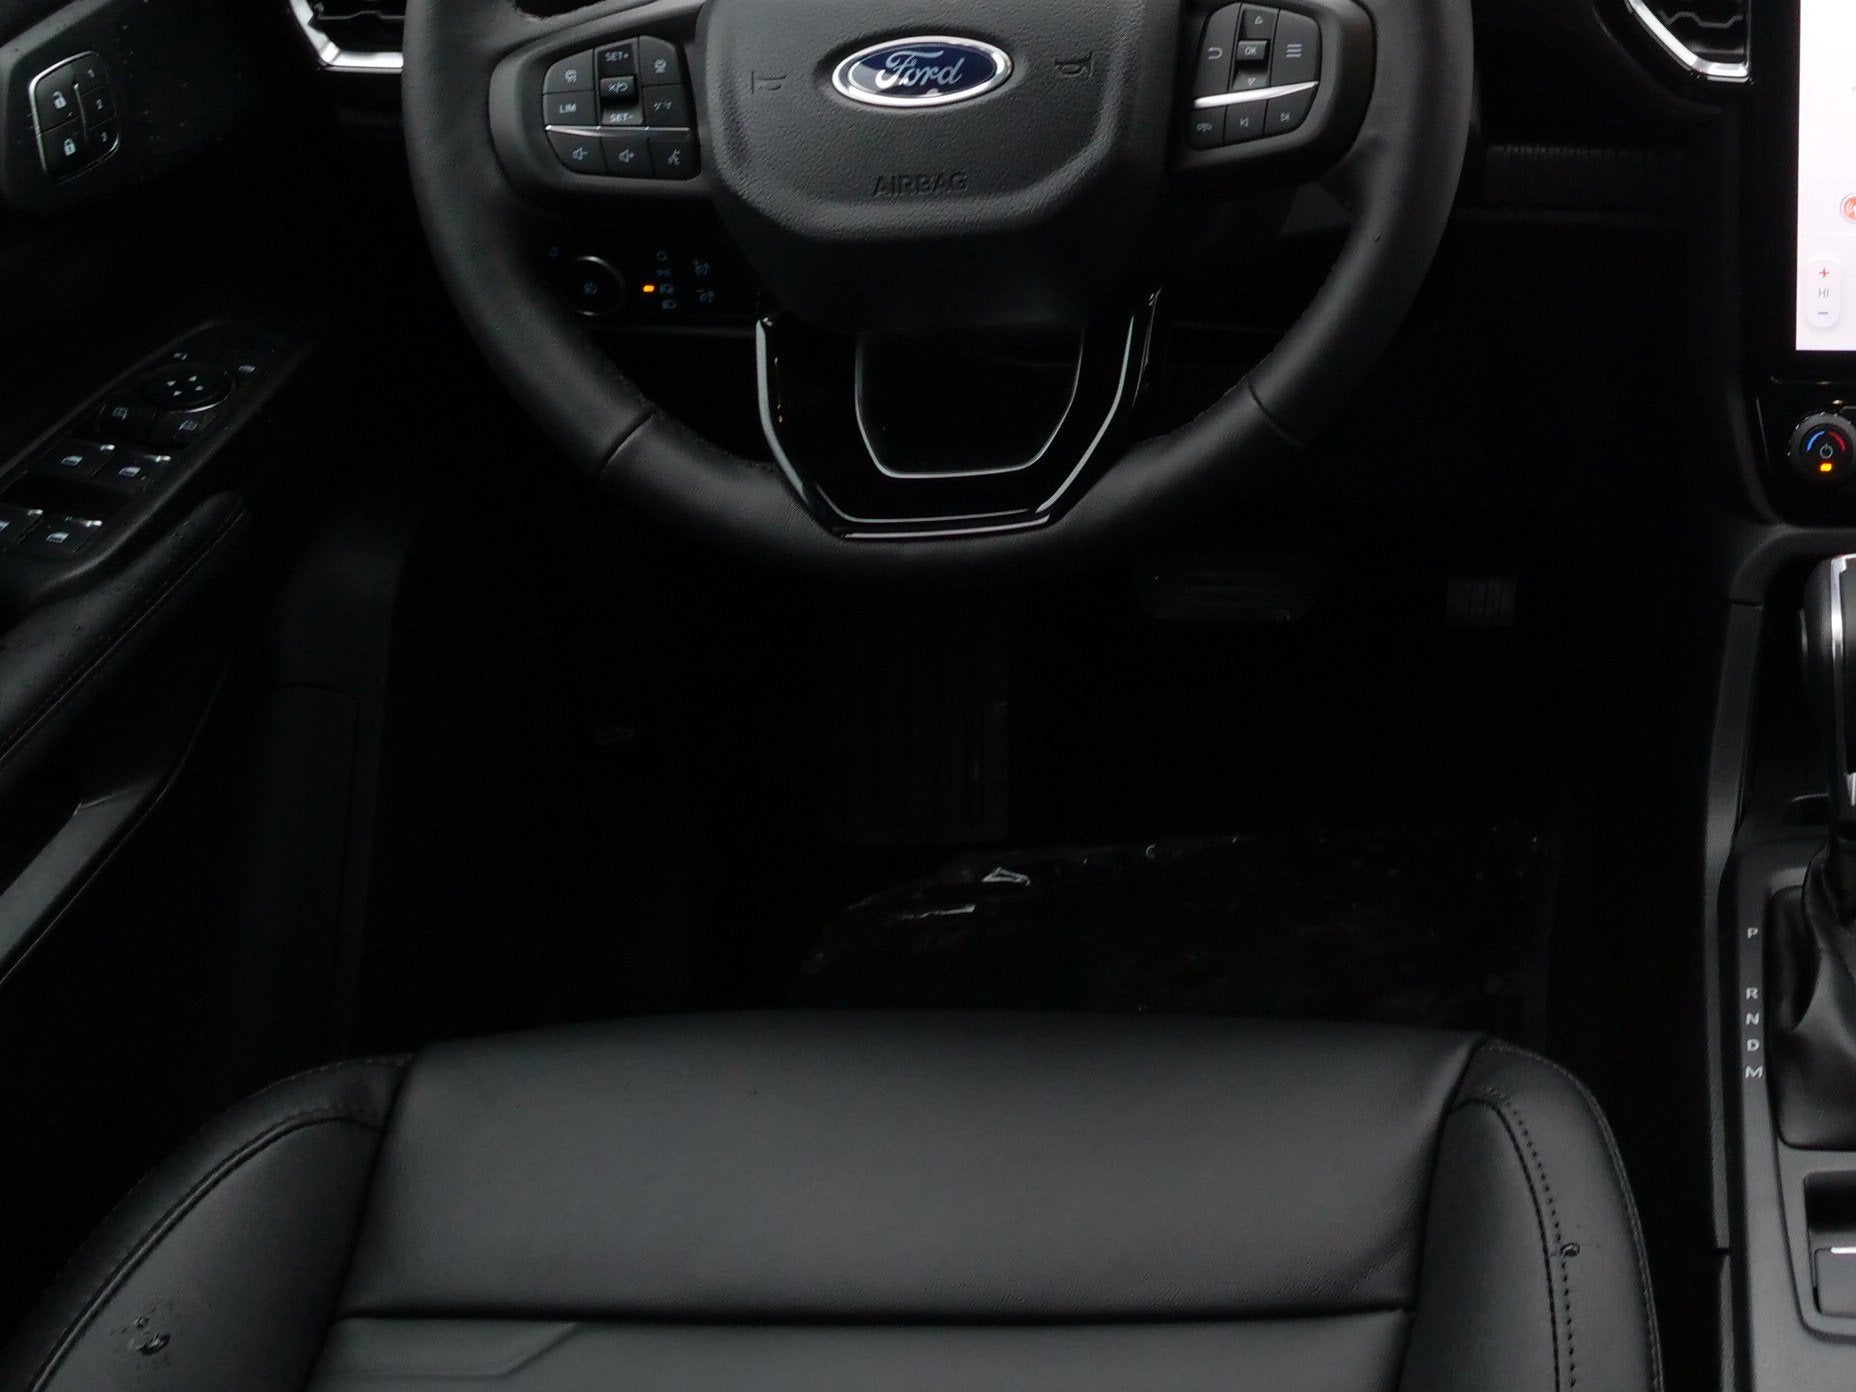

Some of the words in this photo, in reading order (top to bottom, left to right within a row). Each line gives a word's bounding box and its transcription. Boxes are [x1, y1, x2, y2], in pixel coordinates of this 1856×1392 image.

[1244, 46, 1257, 55] OK
[875, 50, 966, 89] Ford
[559, 103, 577, 114] LIM
[871, 170, 969, 196] AIRBAG
[1747, 926, 1759, 939] P
[1745, 987, 1759, 1000] R
[1745, 1012, 1760, 1026] N
[1746, 1038, 1760, 1052] D
[1744, 1065, 1763, 1079] M
